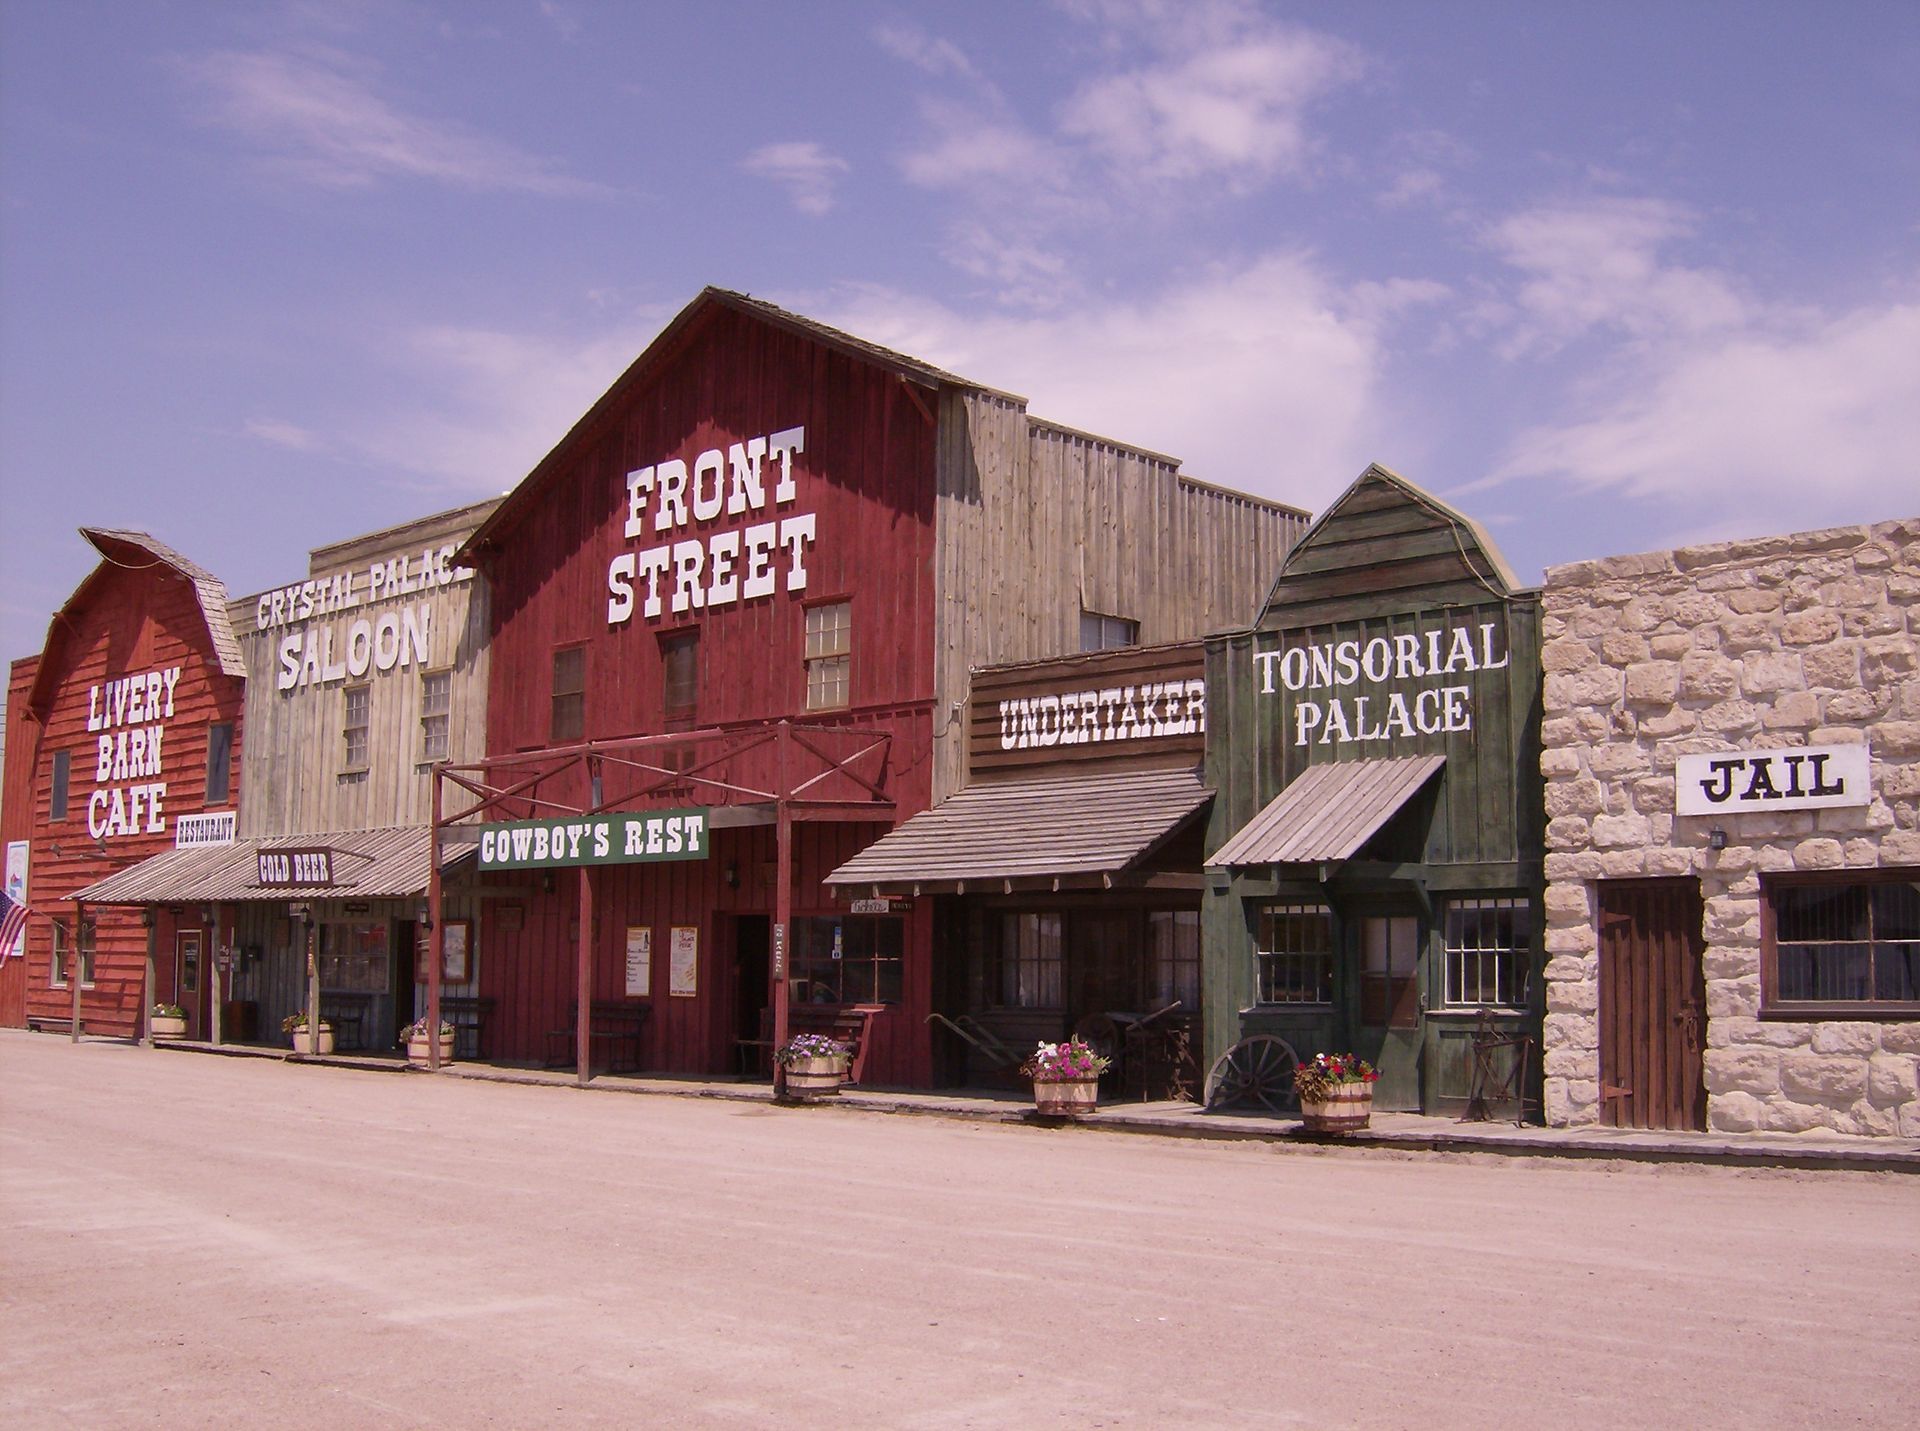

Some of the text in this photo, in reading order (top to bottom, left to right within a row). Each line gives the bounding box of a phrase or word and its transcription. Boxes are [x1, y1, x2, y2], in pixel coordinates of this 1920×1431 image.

[625, 426, 805, 539] FRONT
[608, 513, 816, 624] STREET
[257, 571, 359, 630] CRYSTAL
[278, 603, 430, 690] SALOON
[1253, 623, 1508, 694] TONSORIAL
[88, 666, 180, 732] LIVERY
[1000, 678, 1205, 750] UNDERTAKER
[1294, 685, 1471, 746] PALACE
[96, 725, 164, 782] BARN
[1700, 754, 1844, 802] JAIL
[88, 783, 166, 839] CAFE
[178, 816, 234, 844] RESTAURANT
[482, 815, 704, 863] COWBOY'S REST
[259, 853, 329, 883] COLD BEER
